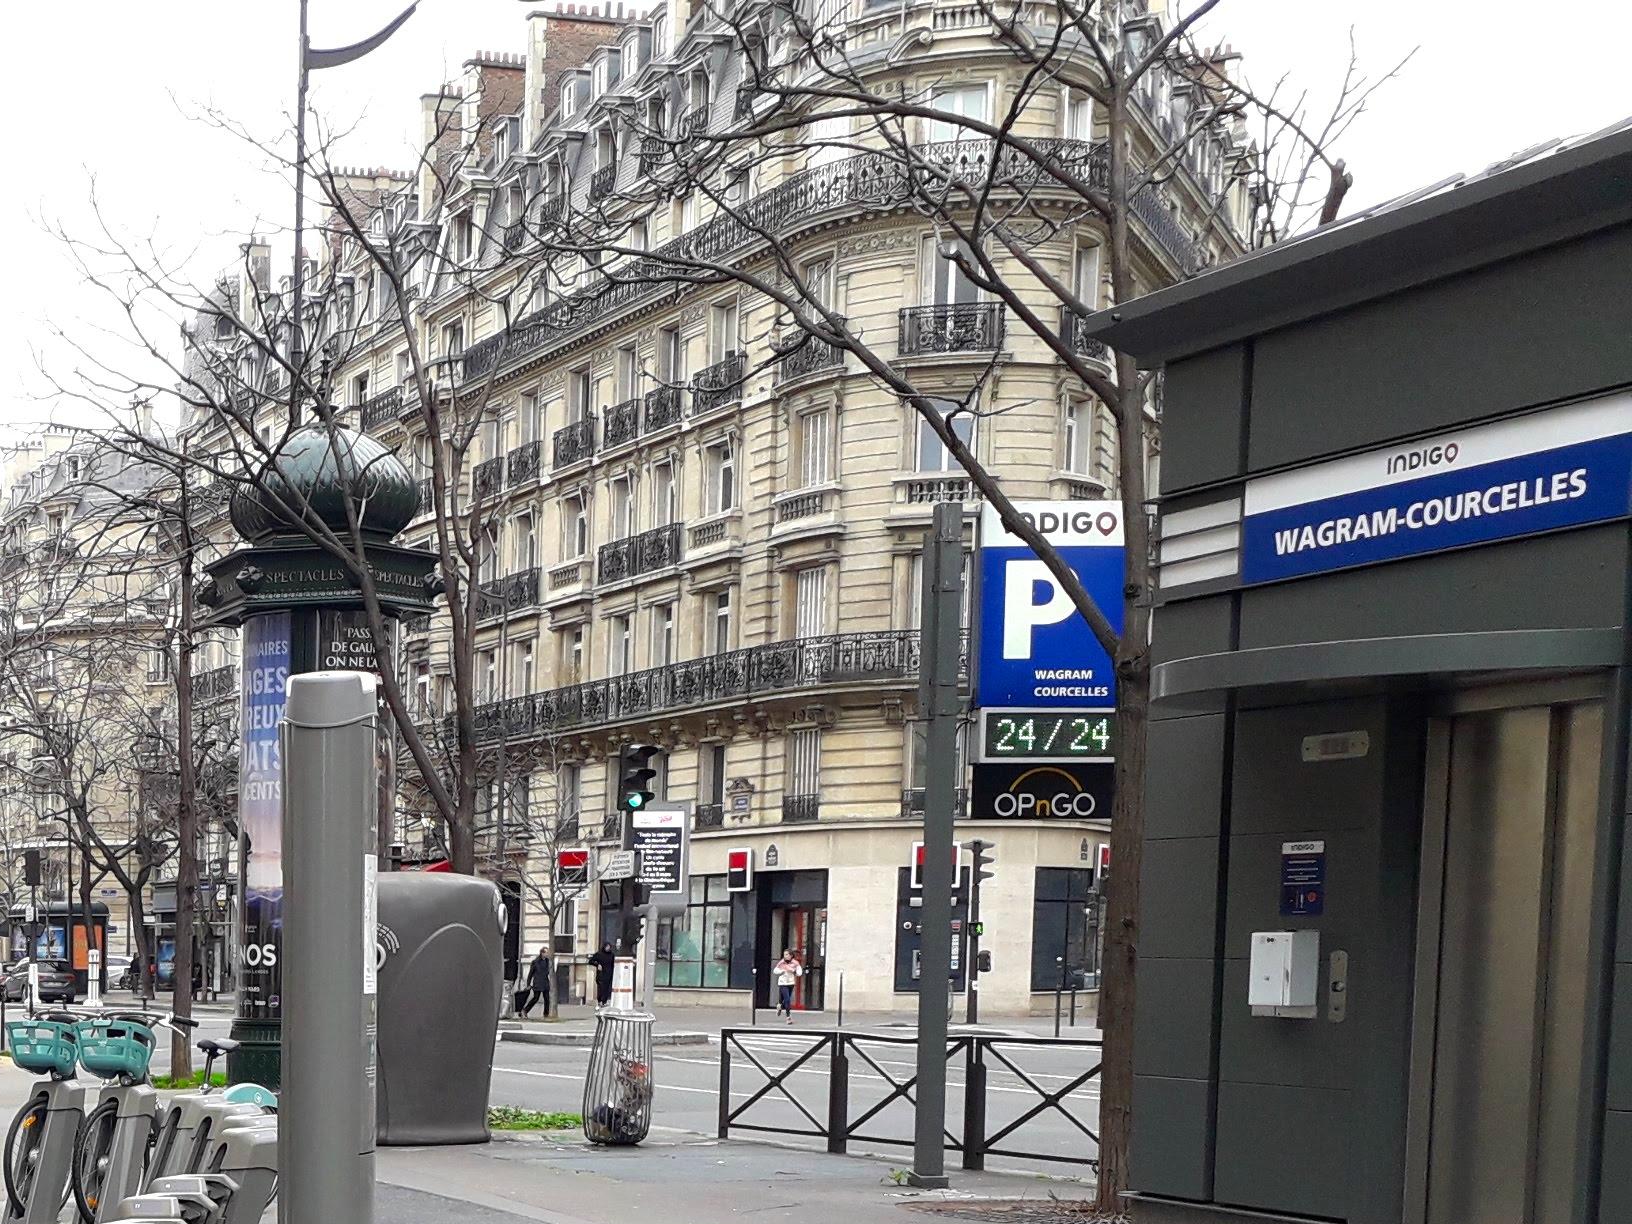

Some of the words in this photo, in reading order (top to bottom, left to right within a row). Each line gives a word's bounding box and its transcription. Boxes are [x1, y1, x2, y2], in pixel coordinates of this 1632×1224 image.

[1387, 443, 1459, 475] INDIGO
[1275, 468, 1587, 555] WAGRAM-COURCELLES
[1004, 511, 1117, 537] NDIGO
[267, 568, 345, 584] SPECTACLES
[374, 569, 424, 588] SPECTACLES
[1003, 559, 1080, 660] P
[331, 642, 348, 653] DE
[325, 656, 346, 668] ON
[349, 656, 365, 668] NE
[1035, 669, 1093, 681] WAGRAM
[1034, 686, 1109, 697] COURCELLES
[994, 792, 1096, 817] OPnGO
